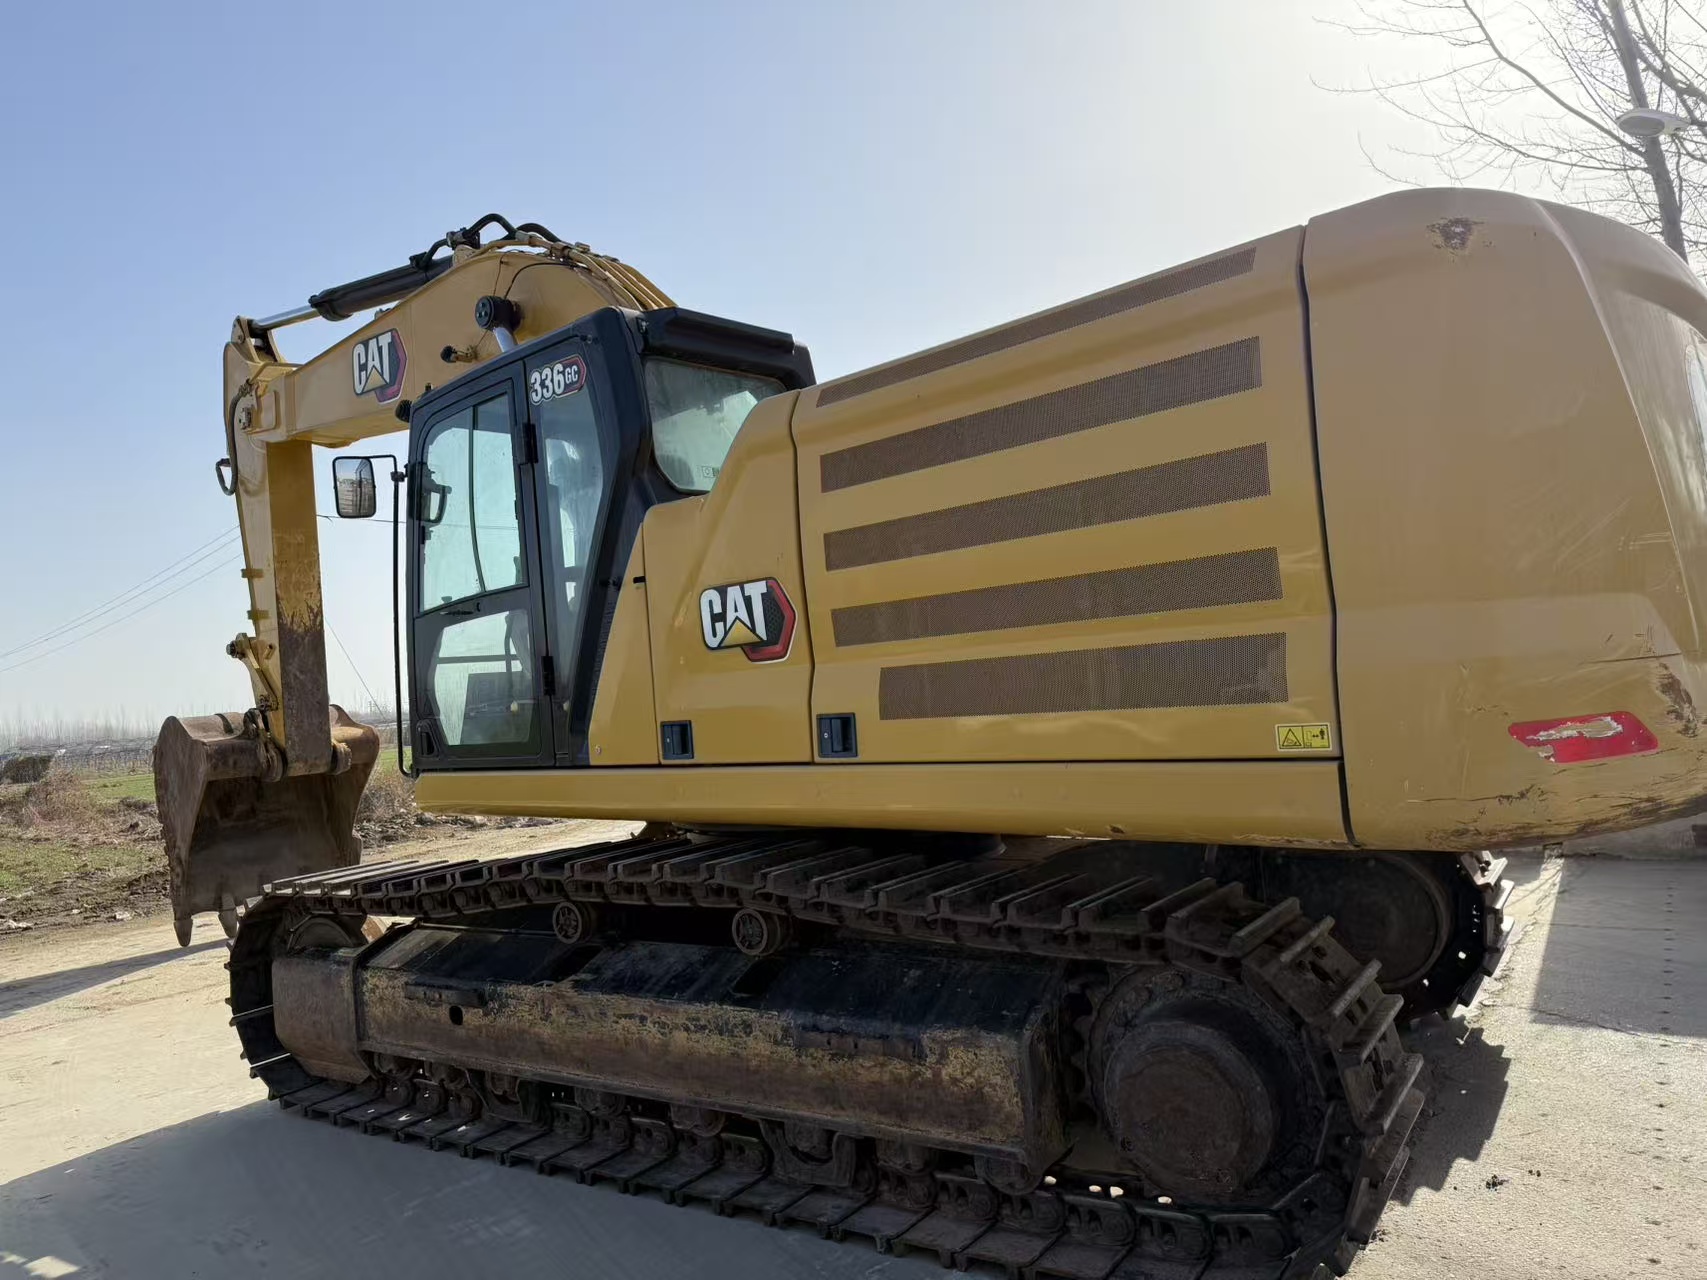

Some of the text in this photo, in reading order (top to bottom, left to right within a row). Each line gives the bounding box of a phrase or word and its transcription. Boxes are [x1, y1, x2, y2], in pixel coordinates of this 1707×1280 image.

[353, 331, 392, 394] CAT
[530, 363, 565, 402] 336
[700, 580, 768, 648] CAT
